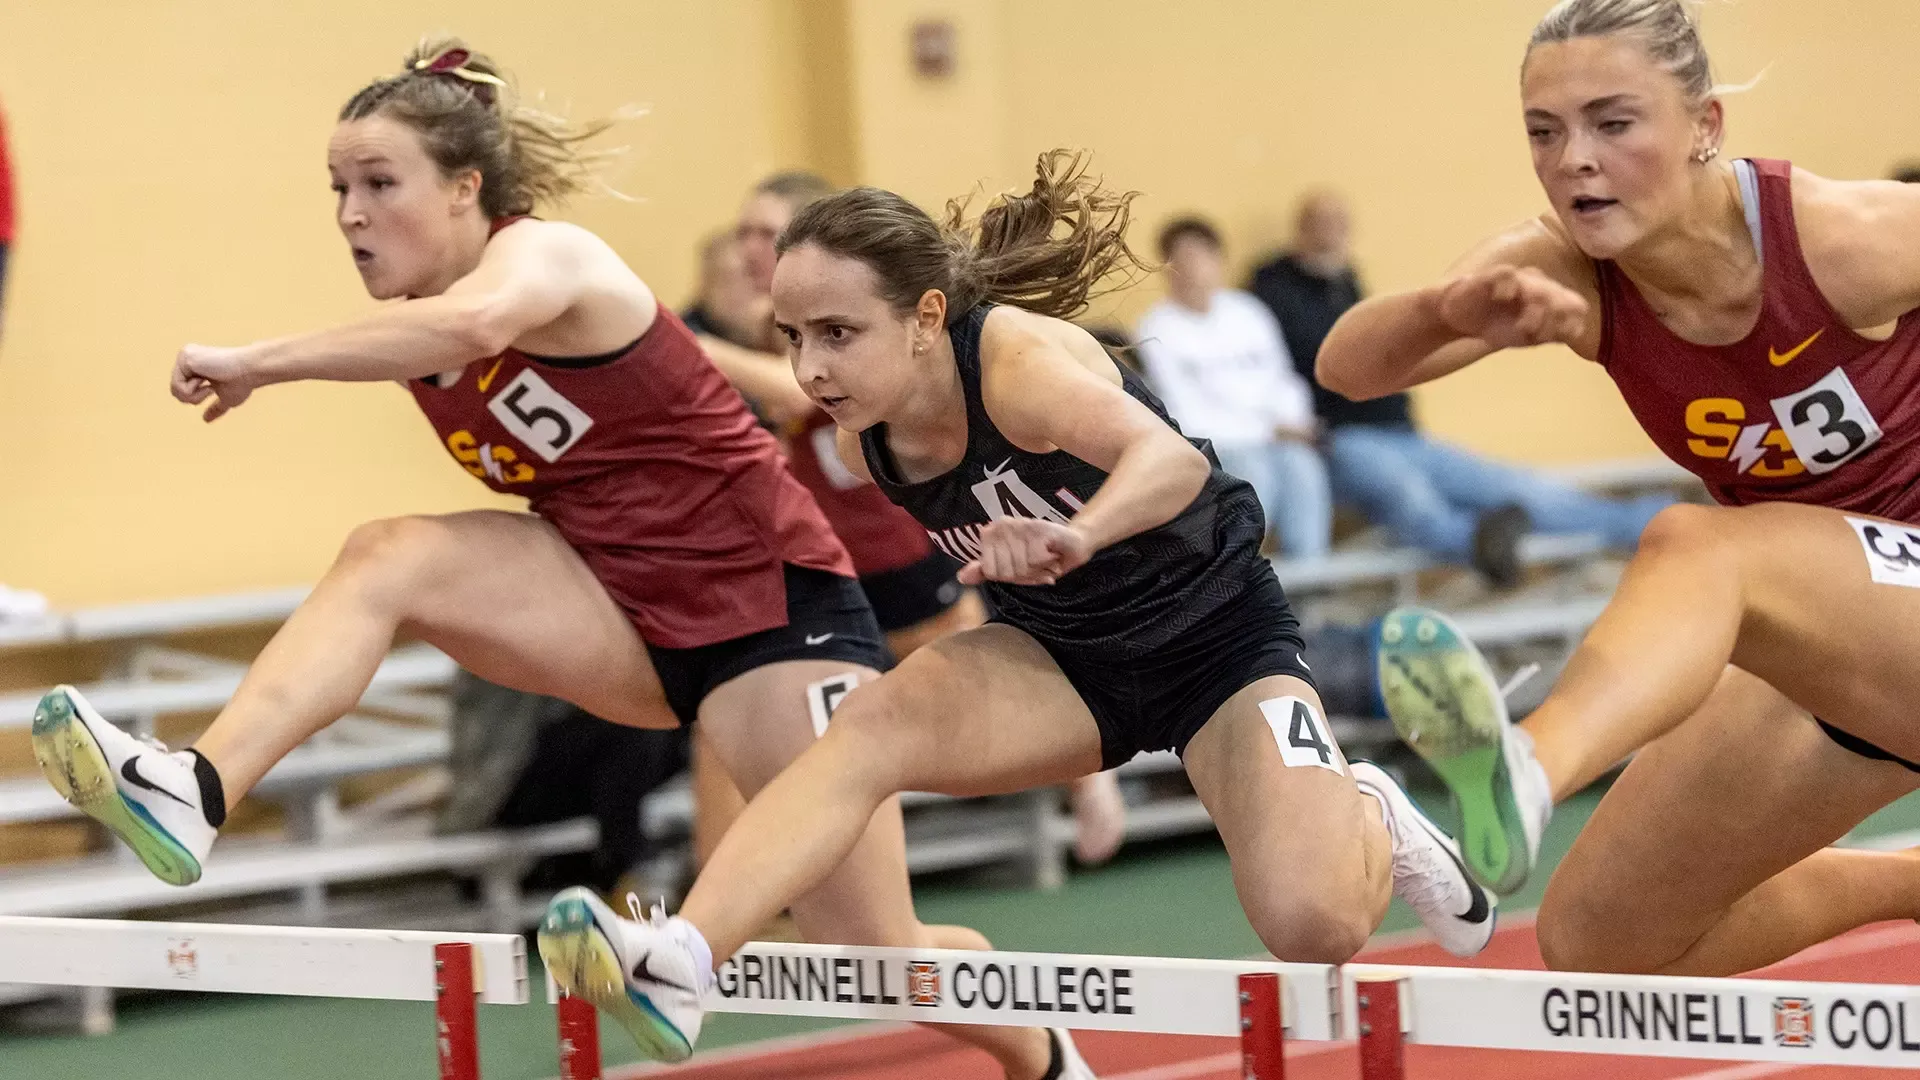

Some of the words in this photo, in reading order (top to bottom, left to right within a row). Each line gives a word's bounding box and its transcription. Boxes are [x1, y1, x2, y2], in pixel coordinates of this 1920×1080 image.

[502, 382, 573, 450] 5
[1791, 389, 1867, 465] 3
[1287, 700, 1332, 765] 4
[716, 954, 898, 1005] GRINNELL
[951, 961, 1136, 1016] COLLEGE
[1541, 986, 1764, 1046] GRINNELL
